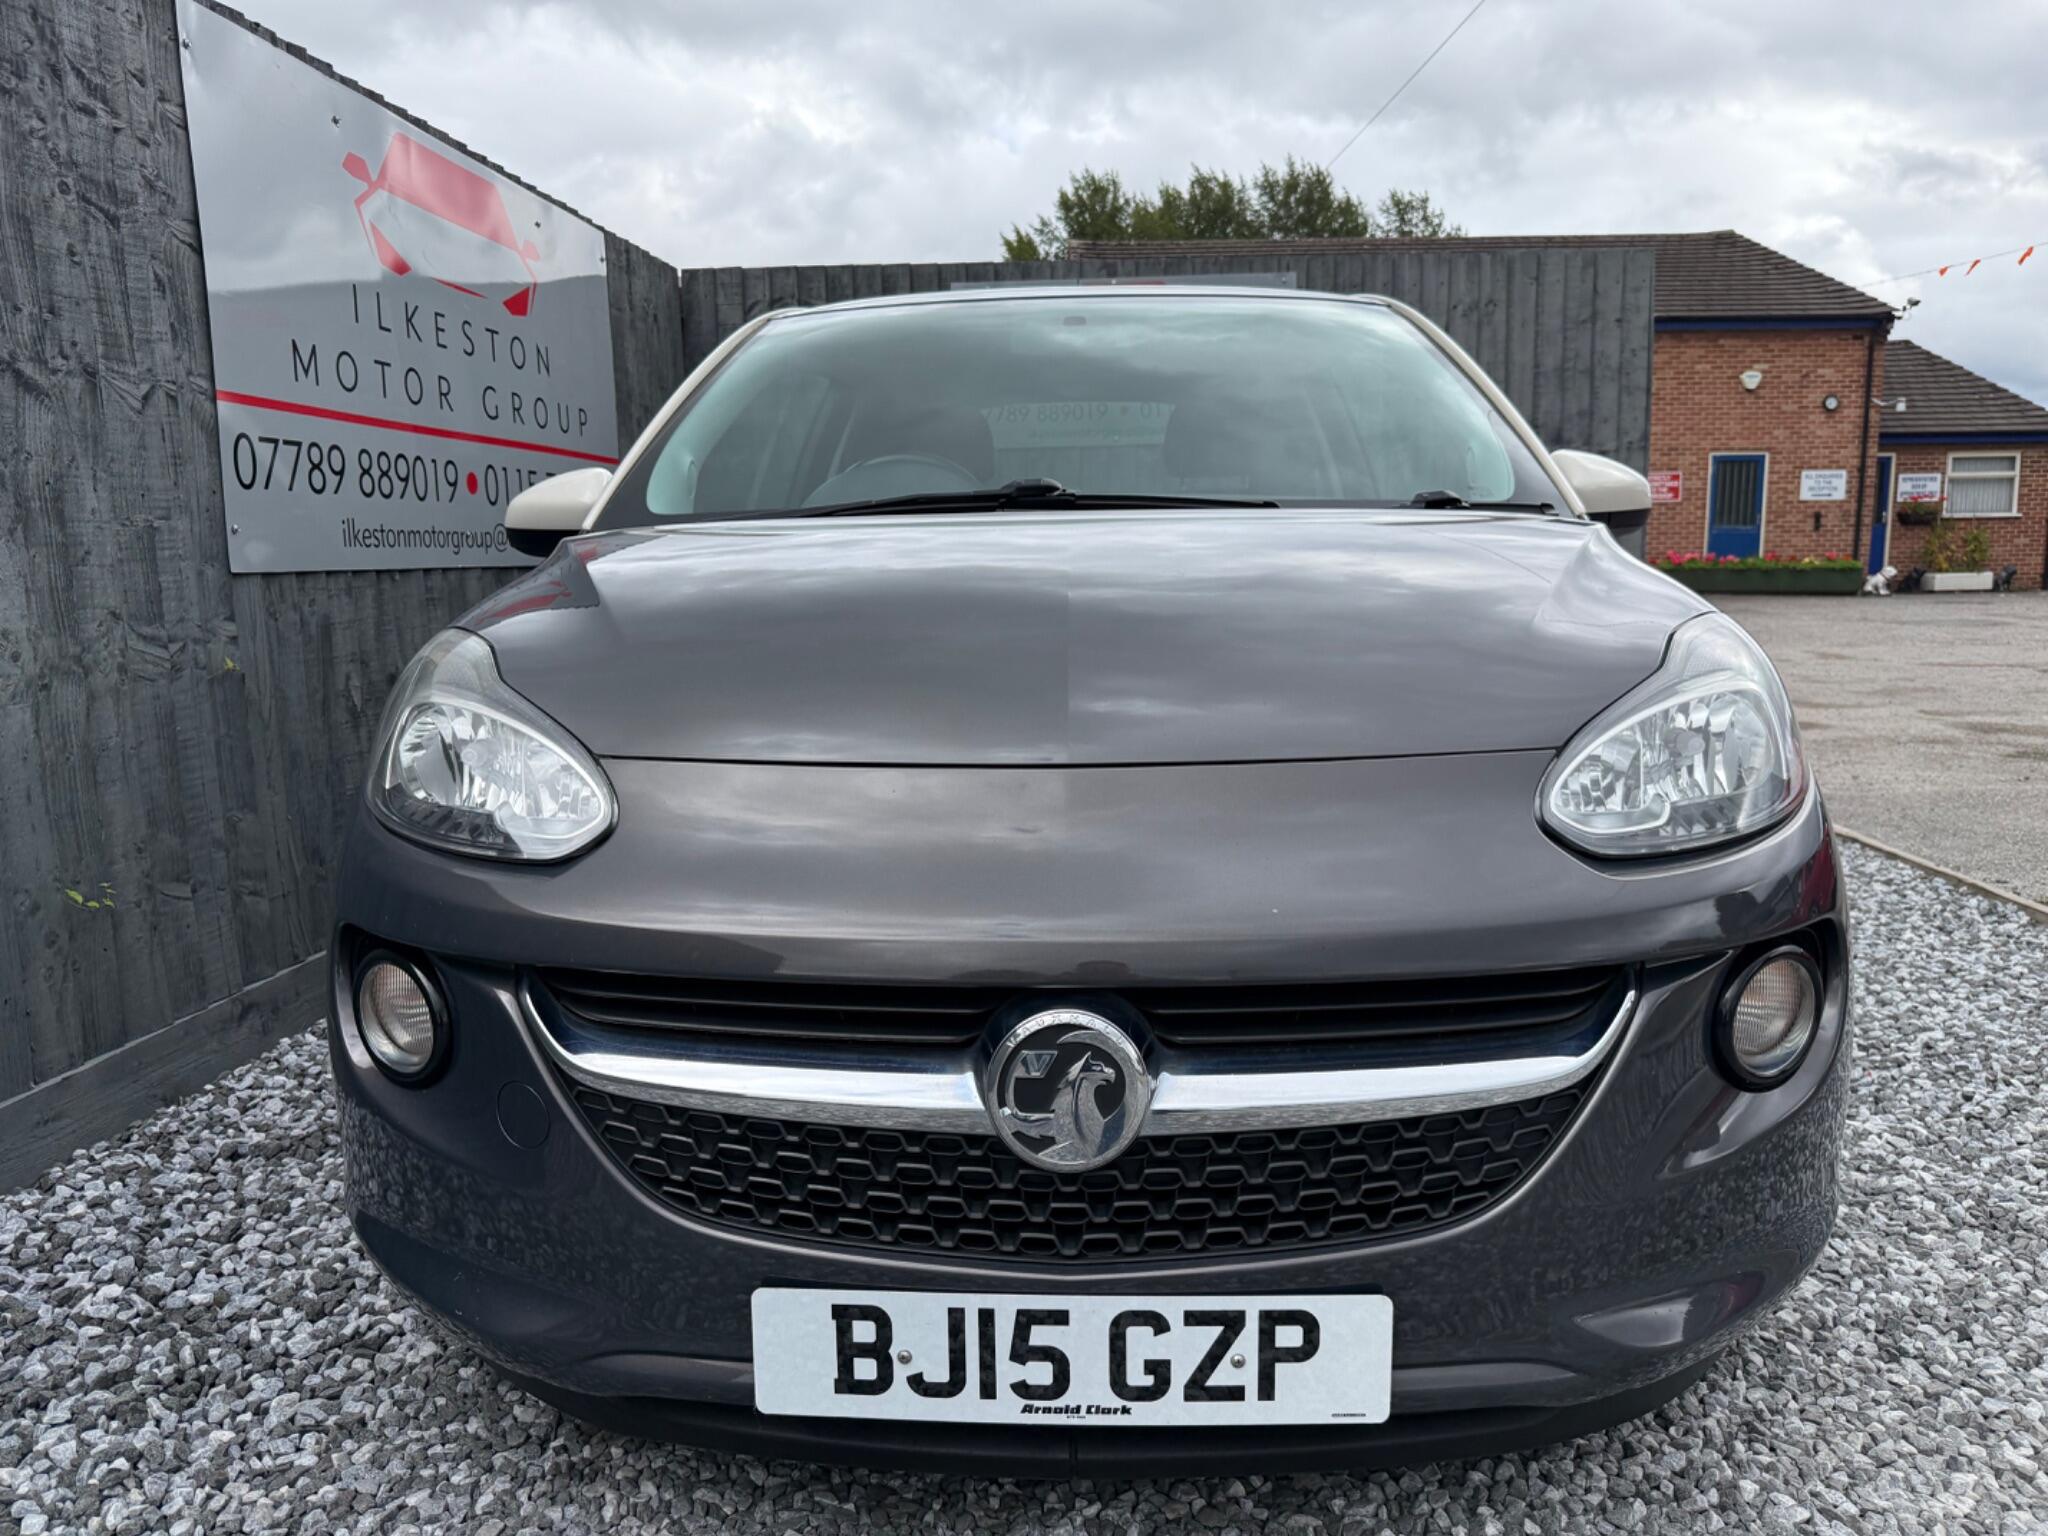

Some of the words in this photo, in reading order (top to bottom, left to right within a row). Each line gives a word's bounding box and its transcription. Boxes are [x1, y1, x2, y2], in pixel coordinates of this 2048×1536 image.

[353, 284, 551, 377] ILKESTON
[291, 338, 454, 412] MOTOR
[482, 385, 588, 437] GROUP
[233, 432, 345, 494] 07789
[358, 448, 459, 503] 889019
[831, 1303, 1071, 1402] BJ15
[1108, 1309, 1320, 1403] GZP
[1020, 1403, 1082, 1415] Arnold
[1085, 1404, 1132, 1416] Clark
